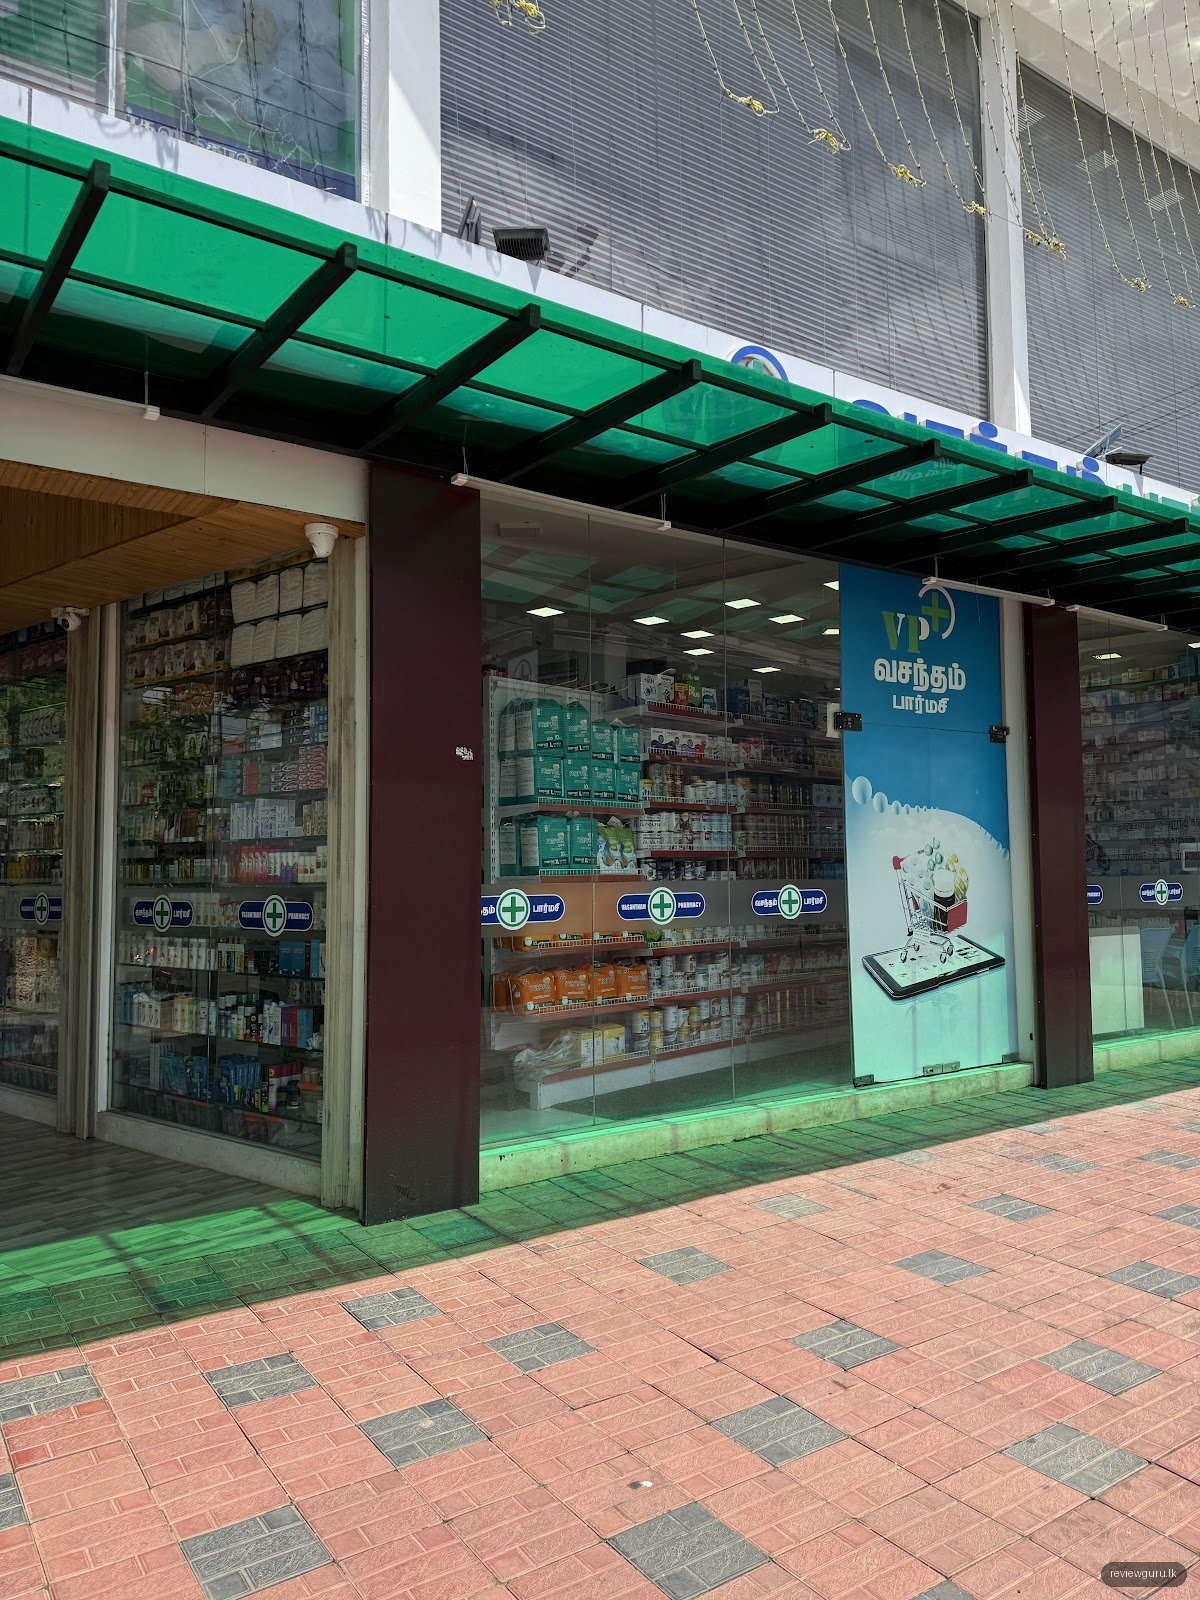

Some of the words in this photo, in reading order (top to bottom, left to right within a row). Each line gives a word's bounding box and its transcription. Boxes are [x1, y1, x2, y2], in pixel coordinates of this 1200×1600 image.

[874, 657, 967, 694] வசந்தம்
[892, 694, 950, 715] பார்மசி
[532, 902, 561, 914] பார்மசி
[677, 901, 702, 909] PHARMACY
